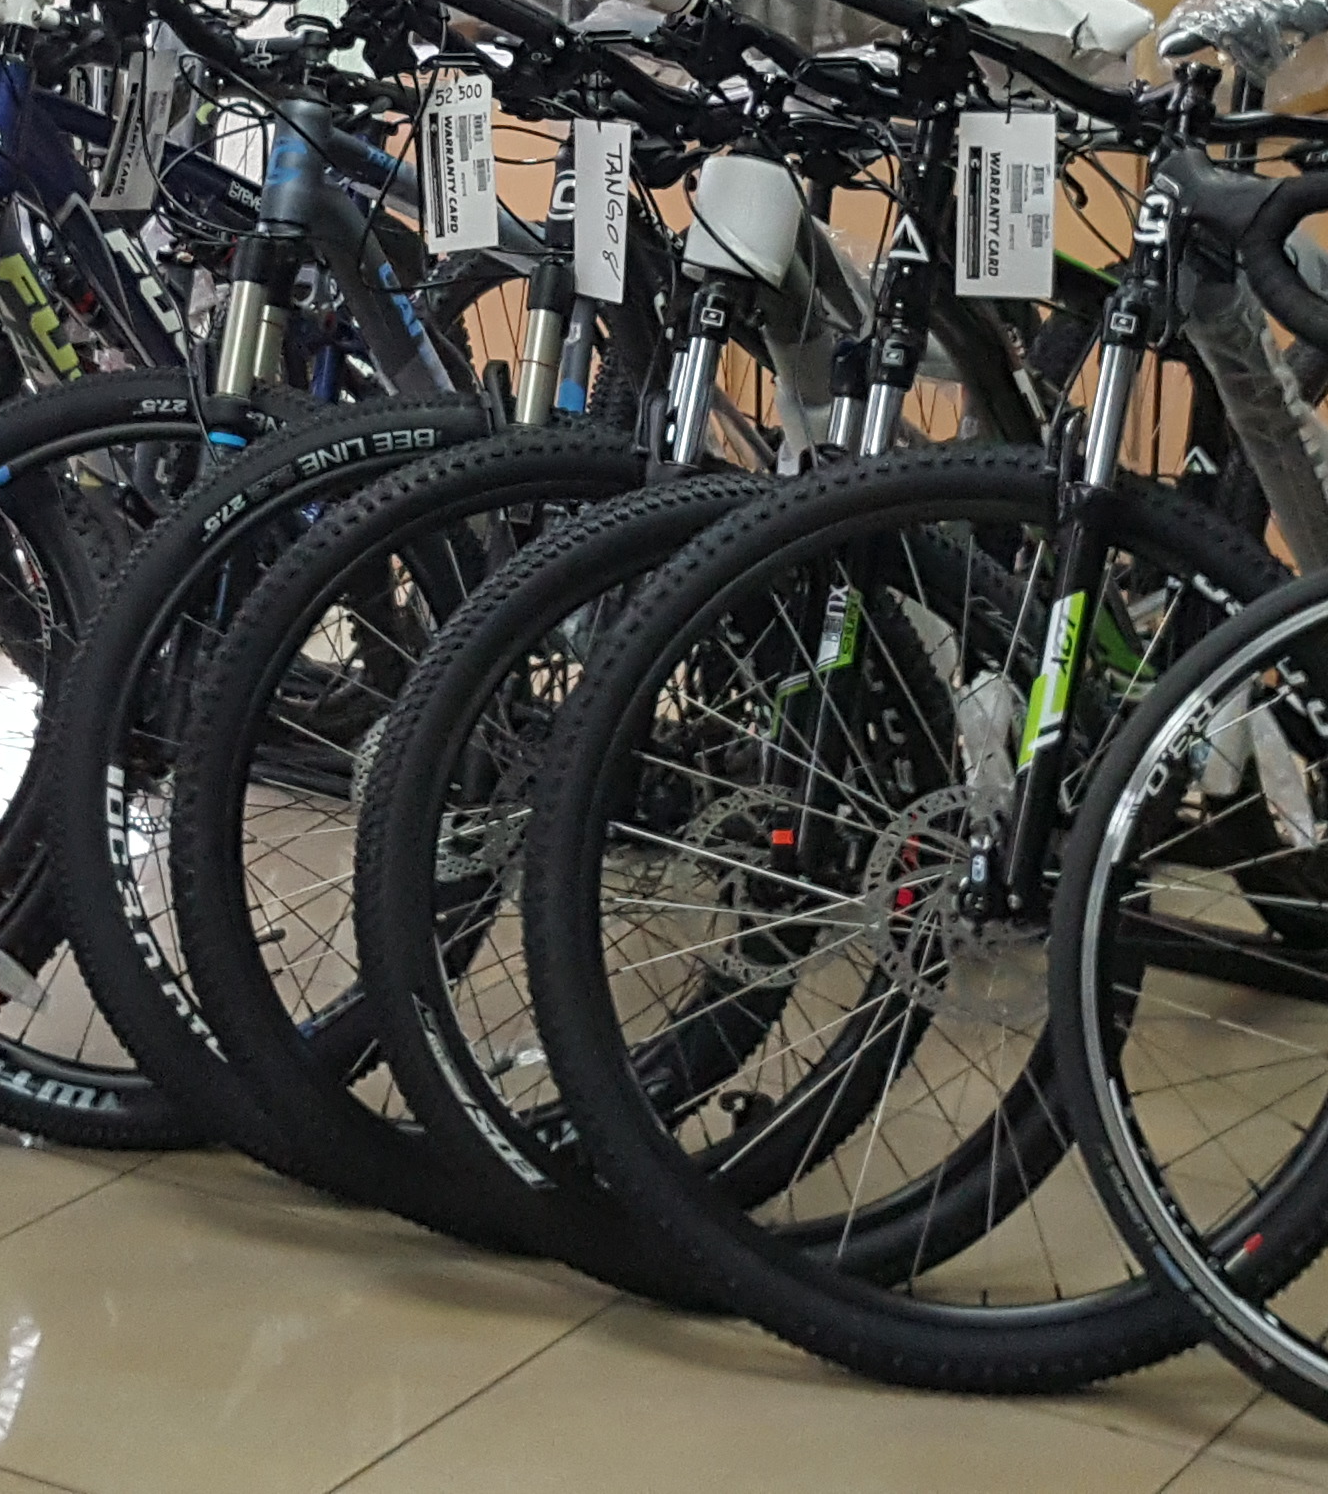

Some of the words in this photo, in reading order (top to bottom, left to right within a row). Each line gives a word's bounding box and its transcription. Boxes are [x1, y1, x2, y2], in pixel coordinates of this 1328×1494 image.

[443, 115, 458, 196] WARRANTY
[988, 151, 1002, 238] WARRANTY
[449, 196, 460, 234] CARD
[987, 239, 1001, 277] CARD
[296, 437, 367, 476] LINE
[373, 426, 437, 456] BEE
